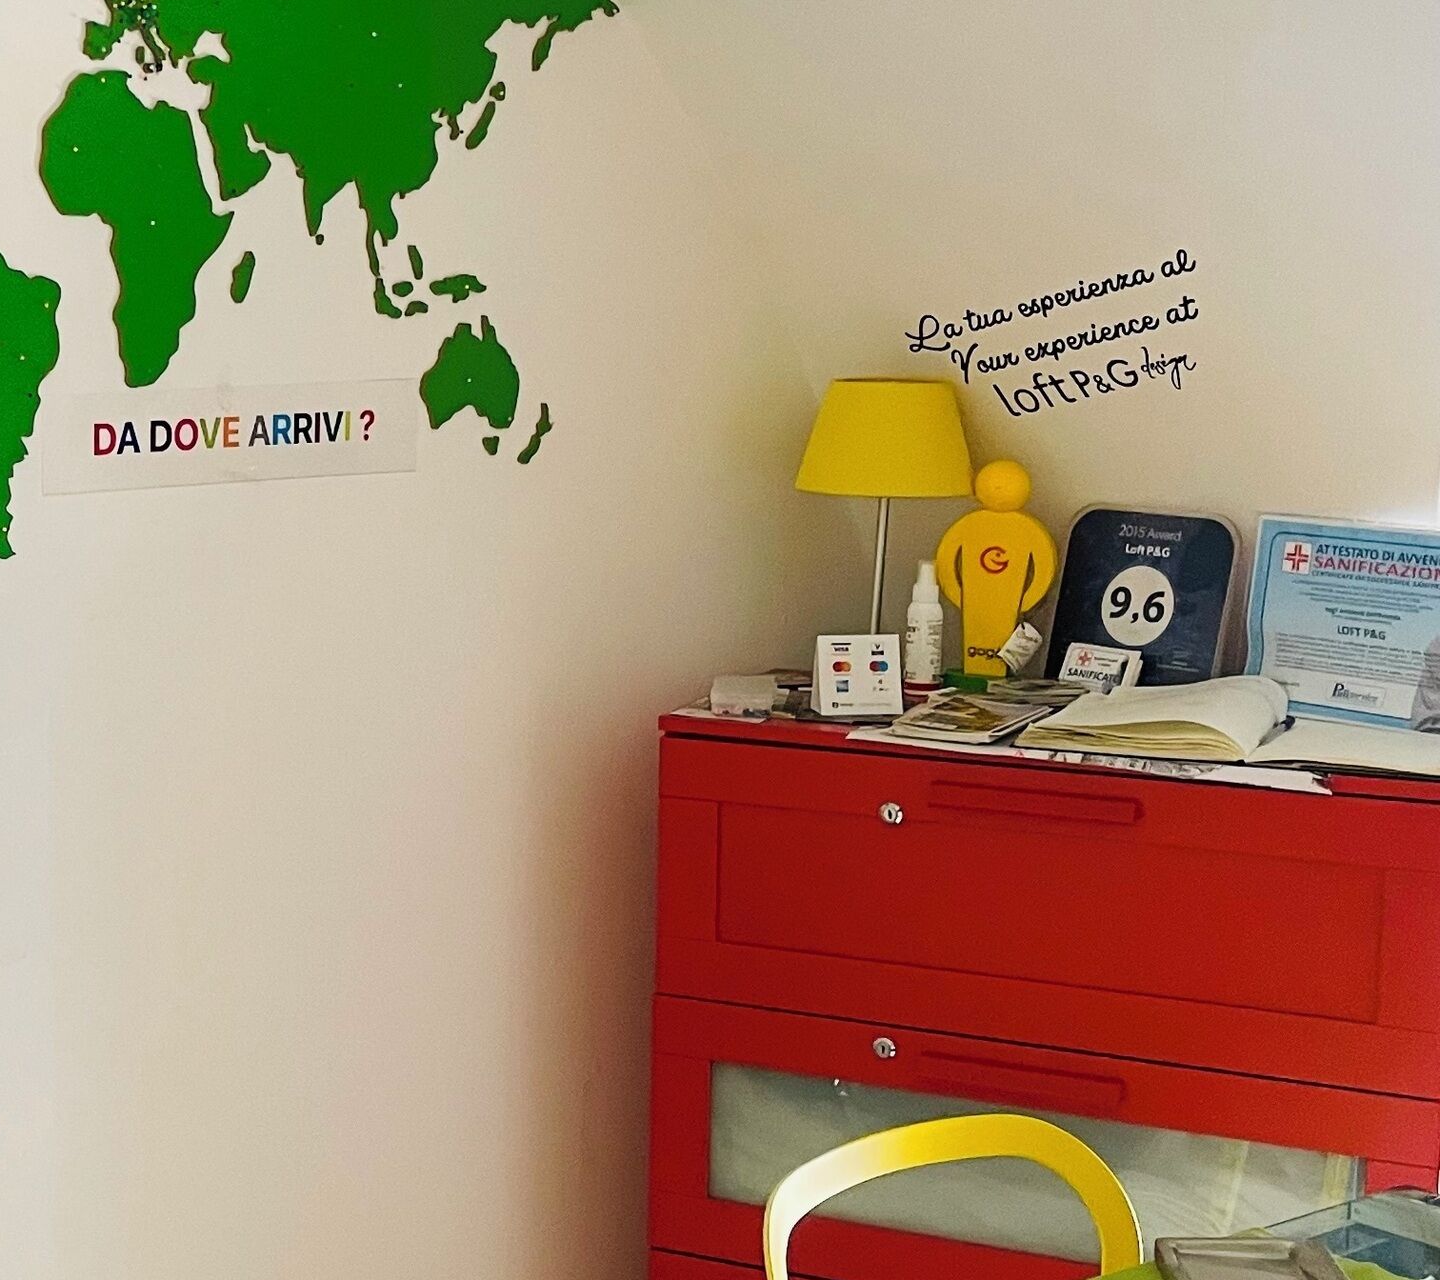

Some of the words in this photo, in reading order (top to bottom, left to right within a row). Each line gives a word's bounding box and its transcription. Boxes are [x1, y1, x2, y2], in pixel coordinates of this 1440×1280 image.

[904, 314, 963, 352] La
[962, 309, 1013, 332] tua
[1017, 268, 1155, 319] esperienza
[1160, 249, 1197, 278] al
[950, 343, 1020, 384] Your
[1024, 314, 1160, 362] experience
[1165, 295, 1199, 324] at
[1068, 358, 1139, 399] P&G
[1140, 346, 1197, 390] design
[93, 421, 141, 456] DA
[149, 416, 240, 453] DOVE
[248, 410, 351, 448] ARRIVI
[359, 409, 375, 441] ?
[1118, 524, 1146, 539] 2015
[1125, 543, 1145, 556] Loft
[1146, 546, 1171, 558] P&G
[1315, 543, 1379, 560] ATTESTATO
[1382, 550, 1396, 562] DI
[1397, 553, 1440, 567] AVVEN
[1109, 586, 1166, 624] 9,6
[1337, 625, 1361, 637] LOFT
[1363, 629, 1386, 640] P&G
